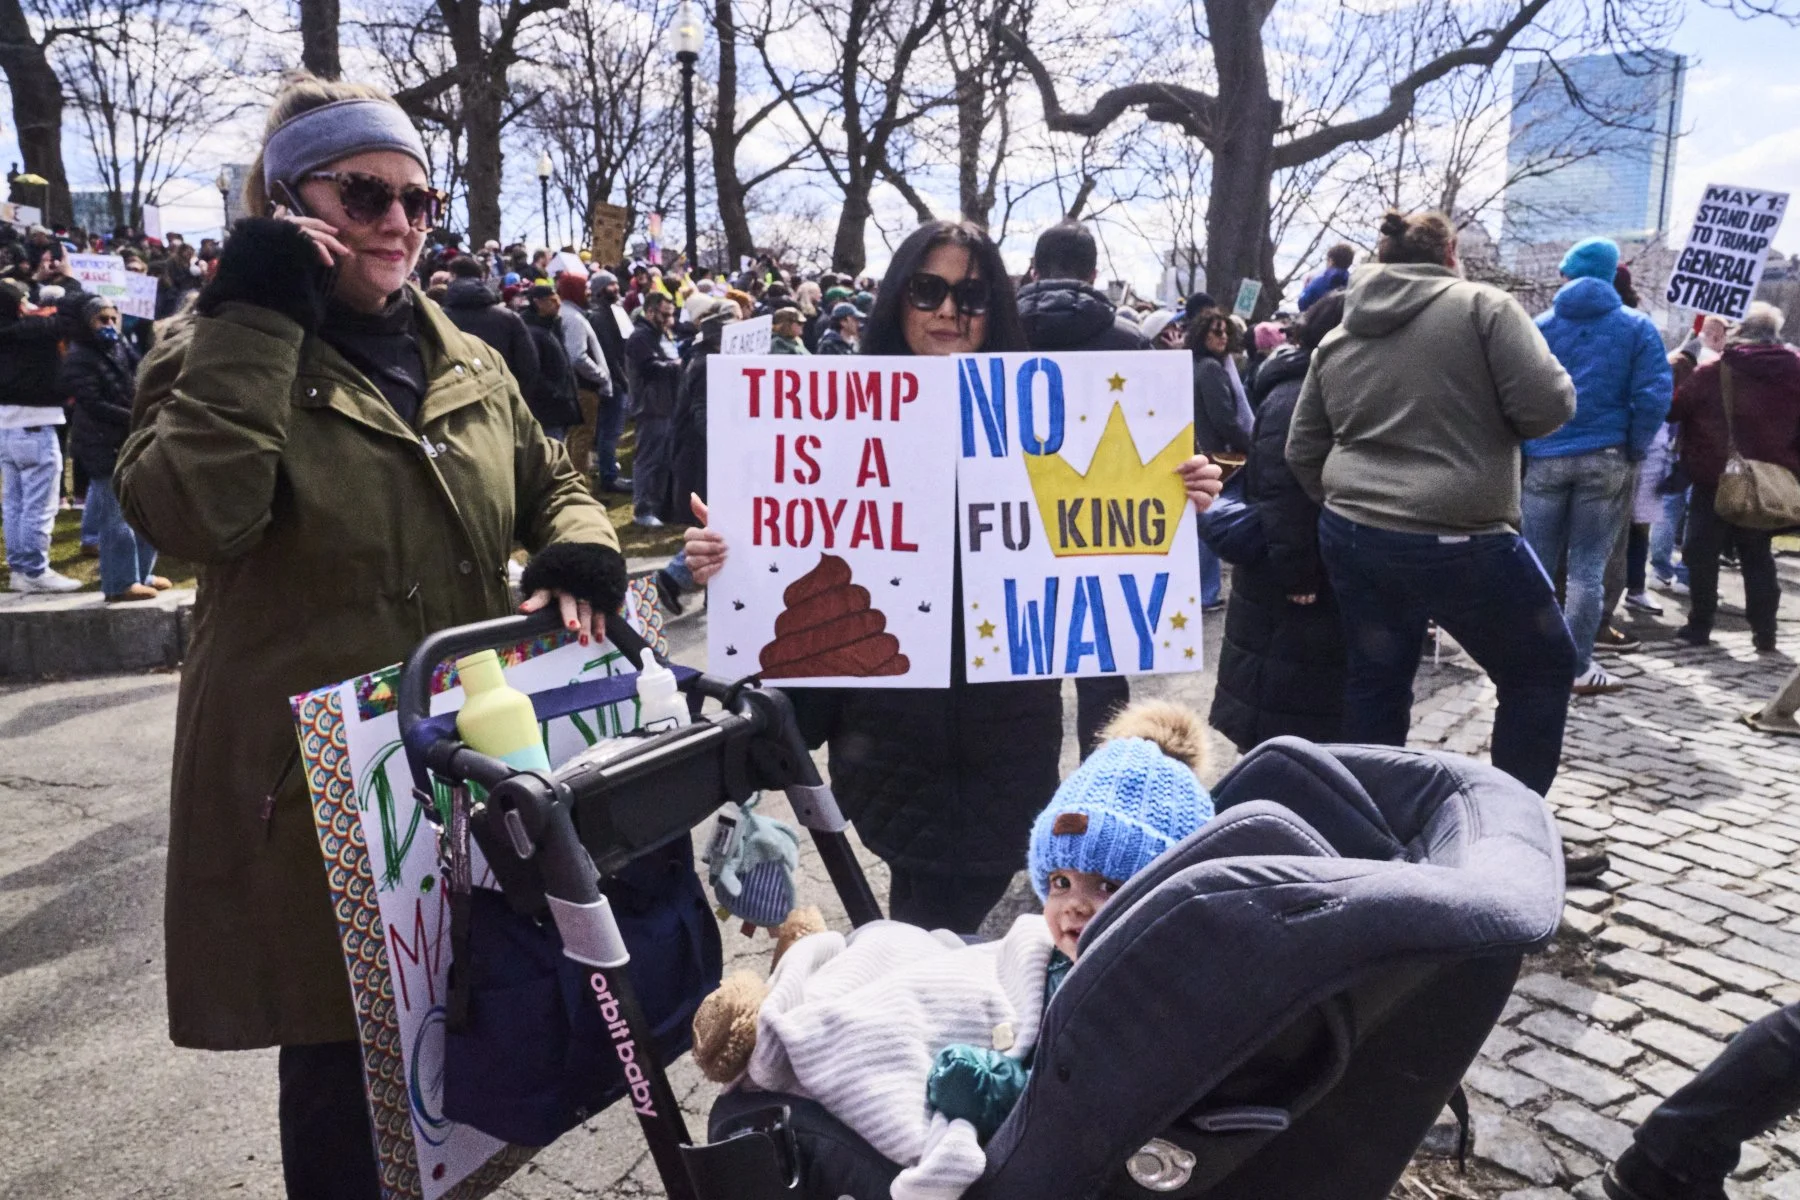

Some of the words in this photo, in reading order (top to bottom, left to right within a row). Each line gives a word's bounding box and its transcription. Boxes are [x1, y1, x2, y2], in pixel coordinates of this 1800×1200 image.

[1697, 204, 1750, 229] STAND
[1749, 213, 1778, 233] UP
[1706, 188, 1761, 207] MAY
[1767, 197, 1785, 212] 1:
[1691, 225, 1713, 244] TO
[1714, 229, 1769, 254] TRUMP
[1677, 247, 1757, 287] GENERAL
[1666, 274, 1751, 319] STRIKE!
[742, 368, 919, 422] TRUMP
[958, 357, 1065, 458] NO
[775, 434, 822, 485] IS
[856, 438, 890, 487] A
[753, 496, 919, 553] ROYAL
[968, 501, 1031, 552] FU
[1057, 497, 1166, 549] KING
[1003, 572, 1170, 676] WAY
[590, 972, 630, 1039] orbit
[615, 1039, 658, 1117] baby
